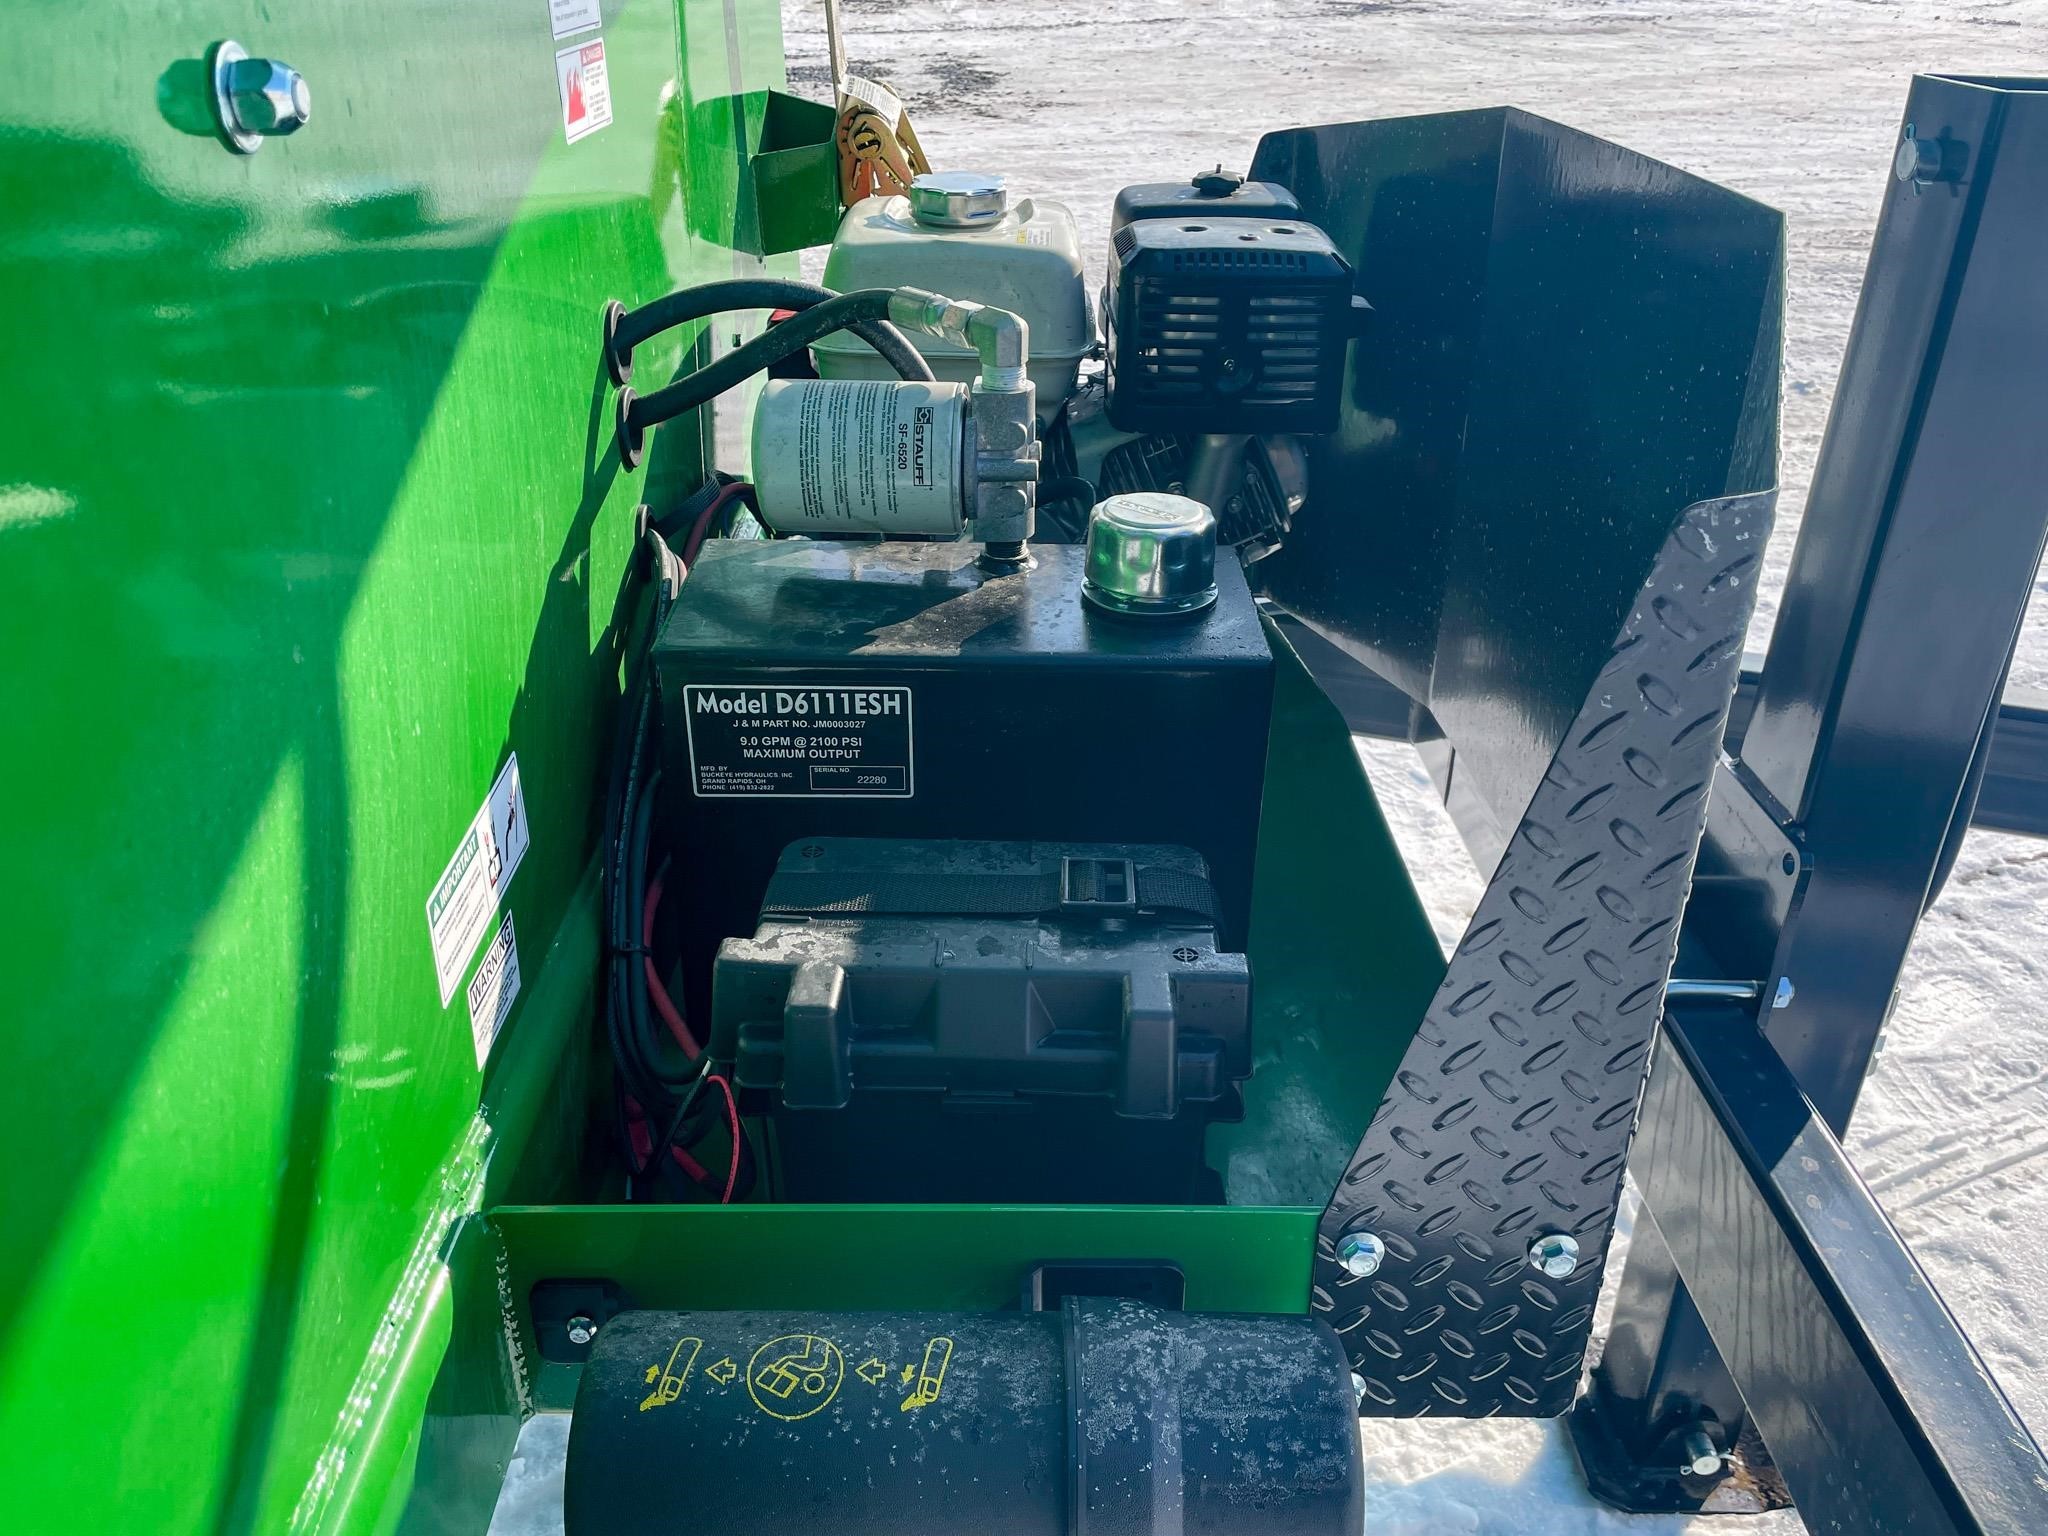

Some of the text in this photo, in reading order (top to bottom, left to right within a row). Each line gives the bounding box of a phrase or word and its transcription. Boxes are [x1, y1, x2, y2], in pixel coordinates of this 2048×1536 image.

[897, 423, 908, 470] SF-6520
[915, 425, 924, 485] STAUFF
[696, 691, 901, 715] Model D6111ESH
[732, 719, 866, 728] J & M PART NO. JM0003027
[740, 736, 862, 748] 9.0 GPM @ 2100 PSI
[808, 749, 861, 759] OUTPUT
[857, 775, 887, 784] 22280
[439, 832, 478, 909] IMPORTANT
[471, 923, 512, 1006] WARNING
